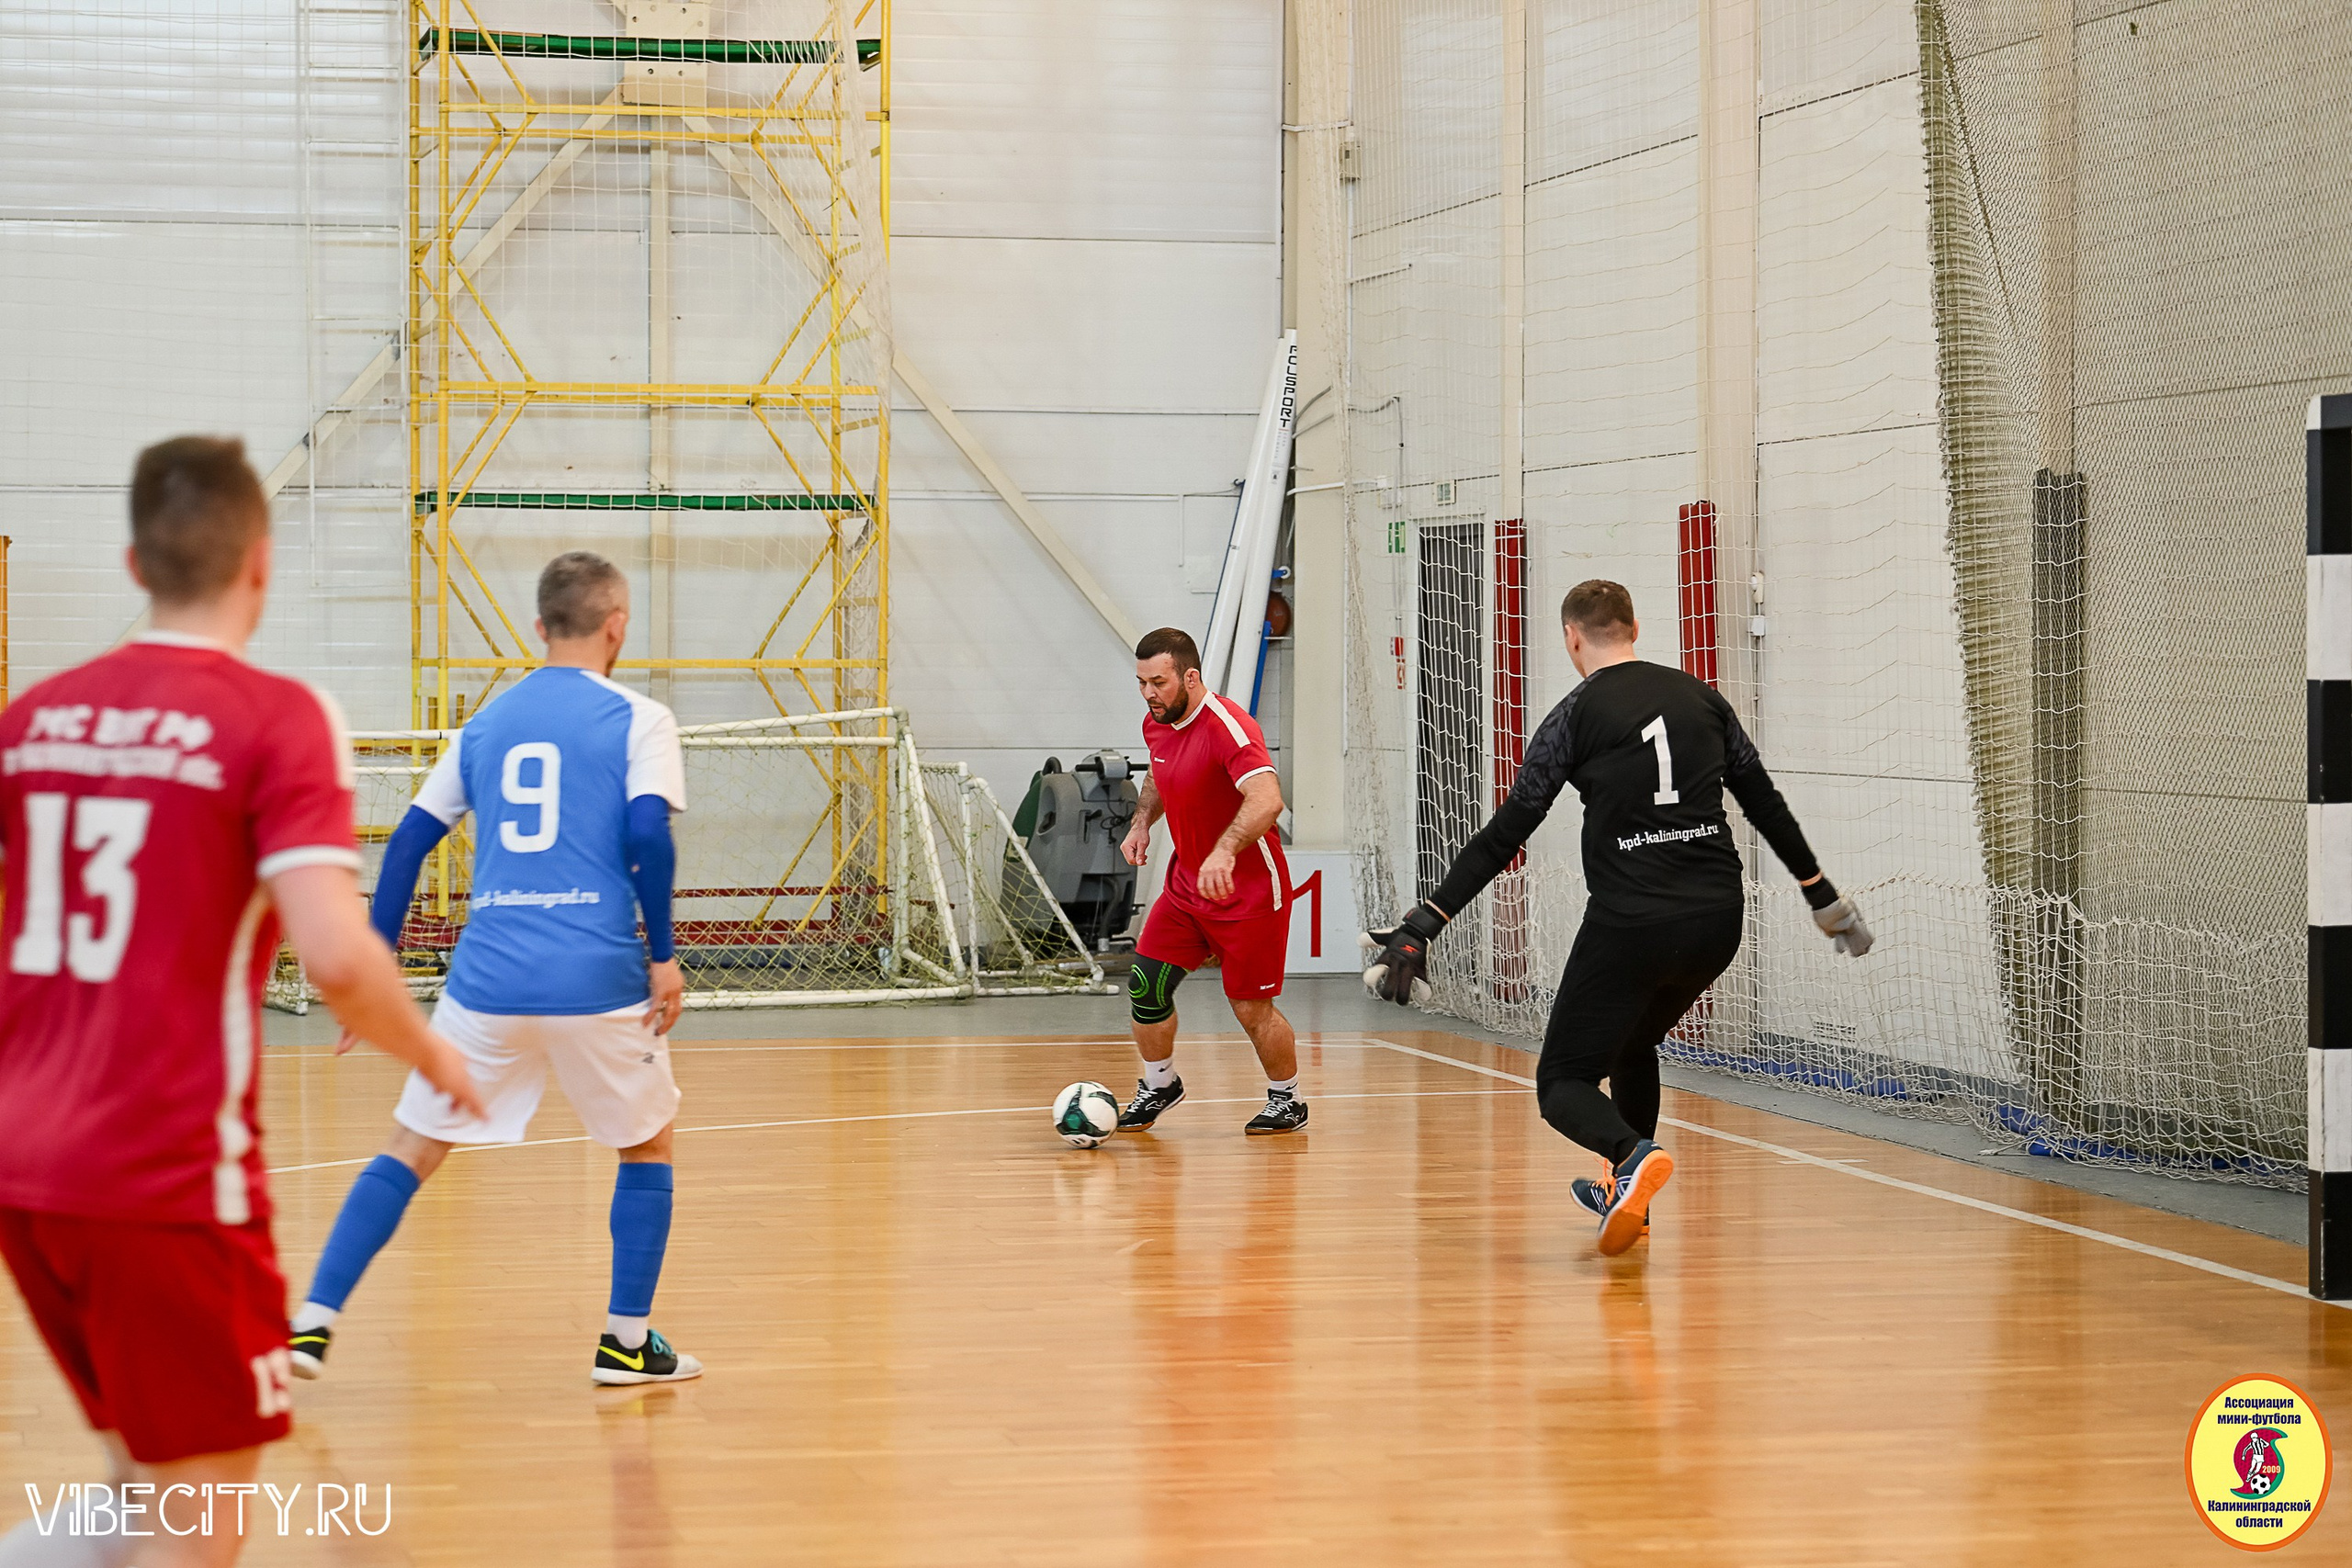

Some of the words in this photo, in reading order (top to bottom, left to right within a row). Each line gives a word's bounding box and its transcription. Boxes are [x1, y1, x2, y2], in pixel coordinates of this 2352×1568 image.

[499, 741, 561, 853] 9
[1641, 715, 1679, 806] 1
[1617, 823, 1720, 852] kpd-kaliningrad.ru
[10, 791, 152, 984] 13
[471, 887, 601, 911] pd-kaliningrad.ru
